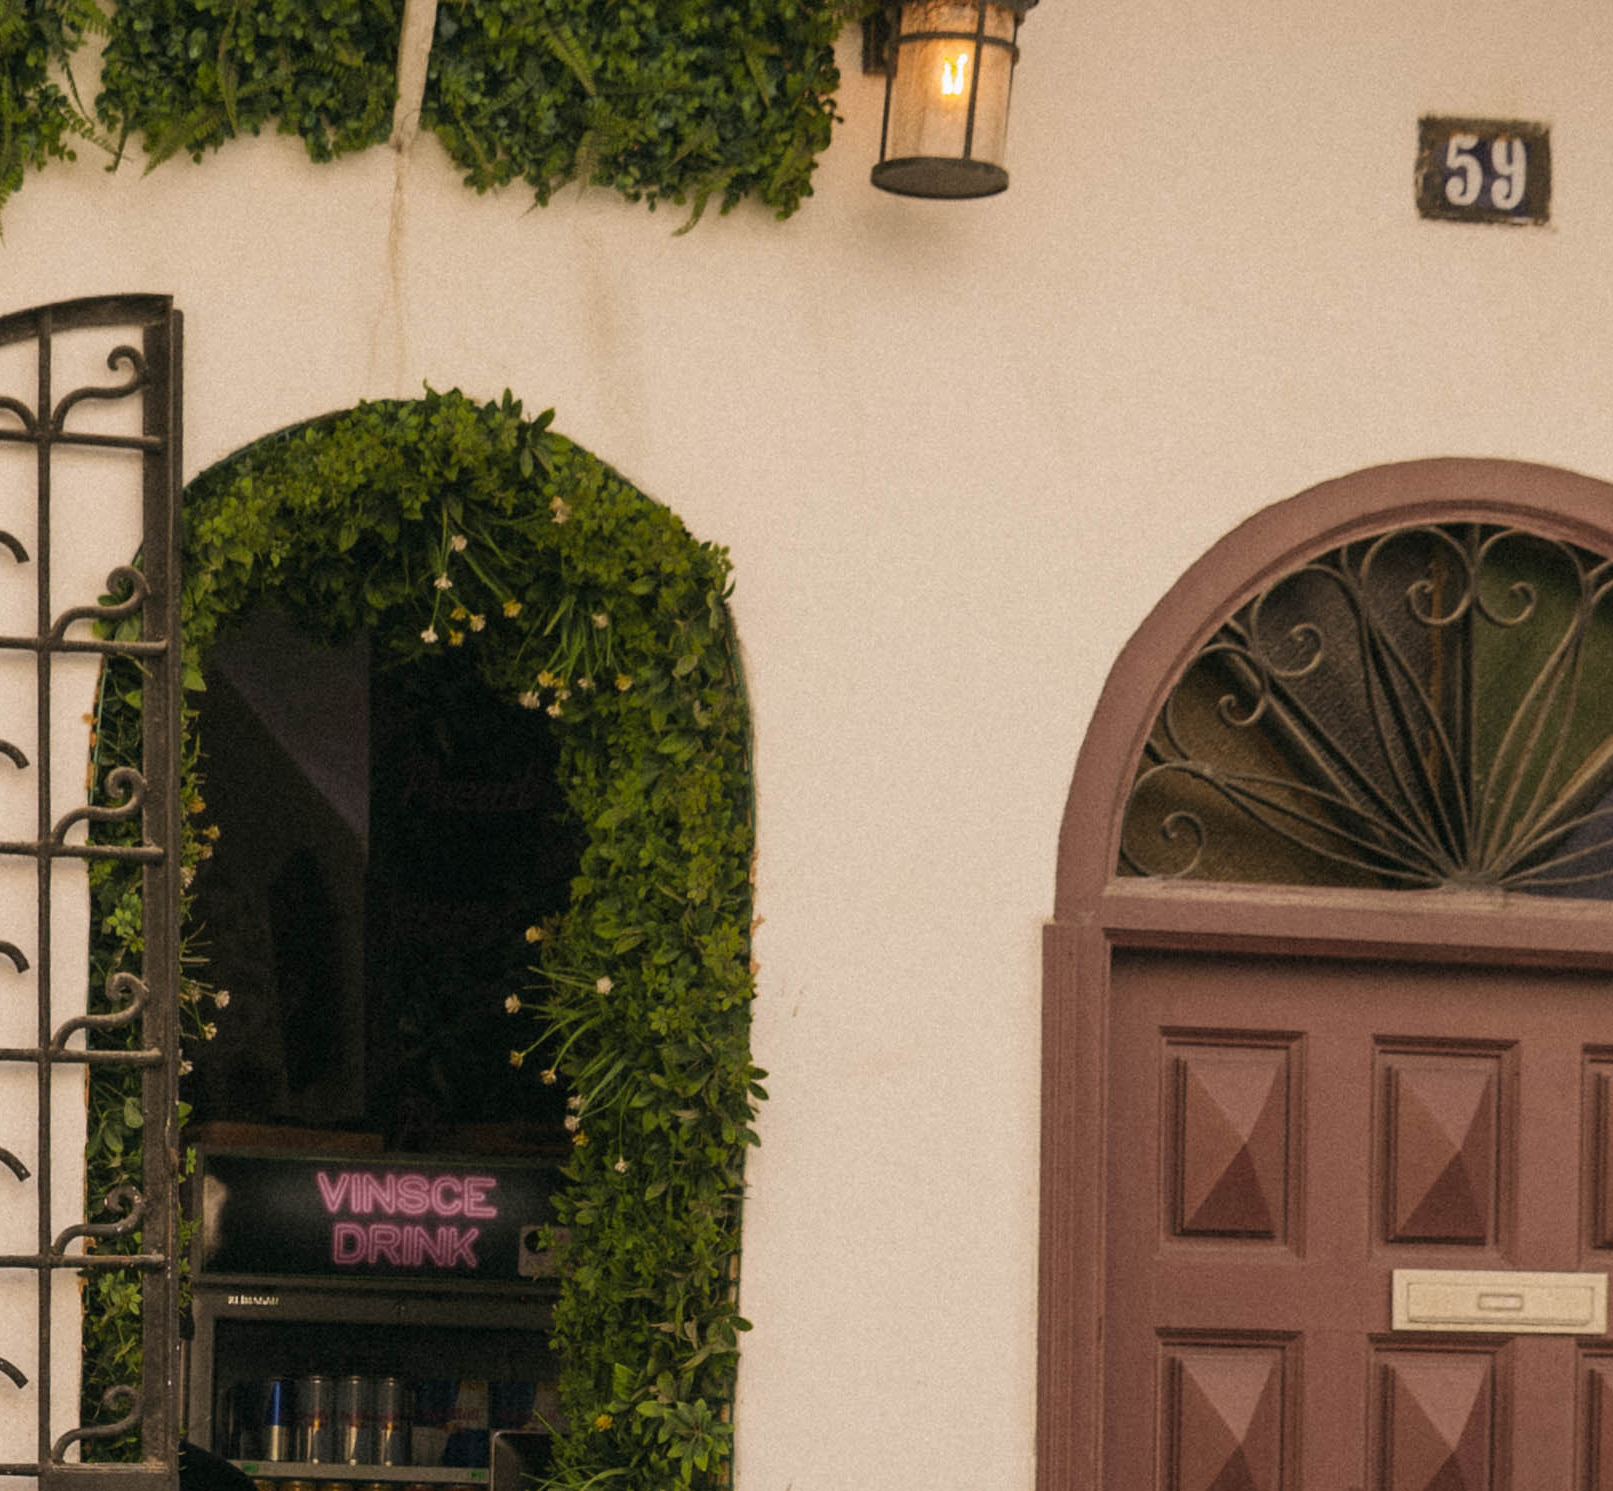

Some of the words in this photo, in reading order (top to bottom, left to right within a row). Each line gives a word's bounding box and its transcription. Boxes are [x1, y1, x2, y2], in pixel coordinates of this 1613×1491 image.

[1444, 132, 1527, 211] 59
[316, 1171, 498, 1219] VINSCE
[333, 1222, 480, 1269] DRINK
